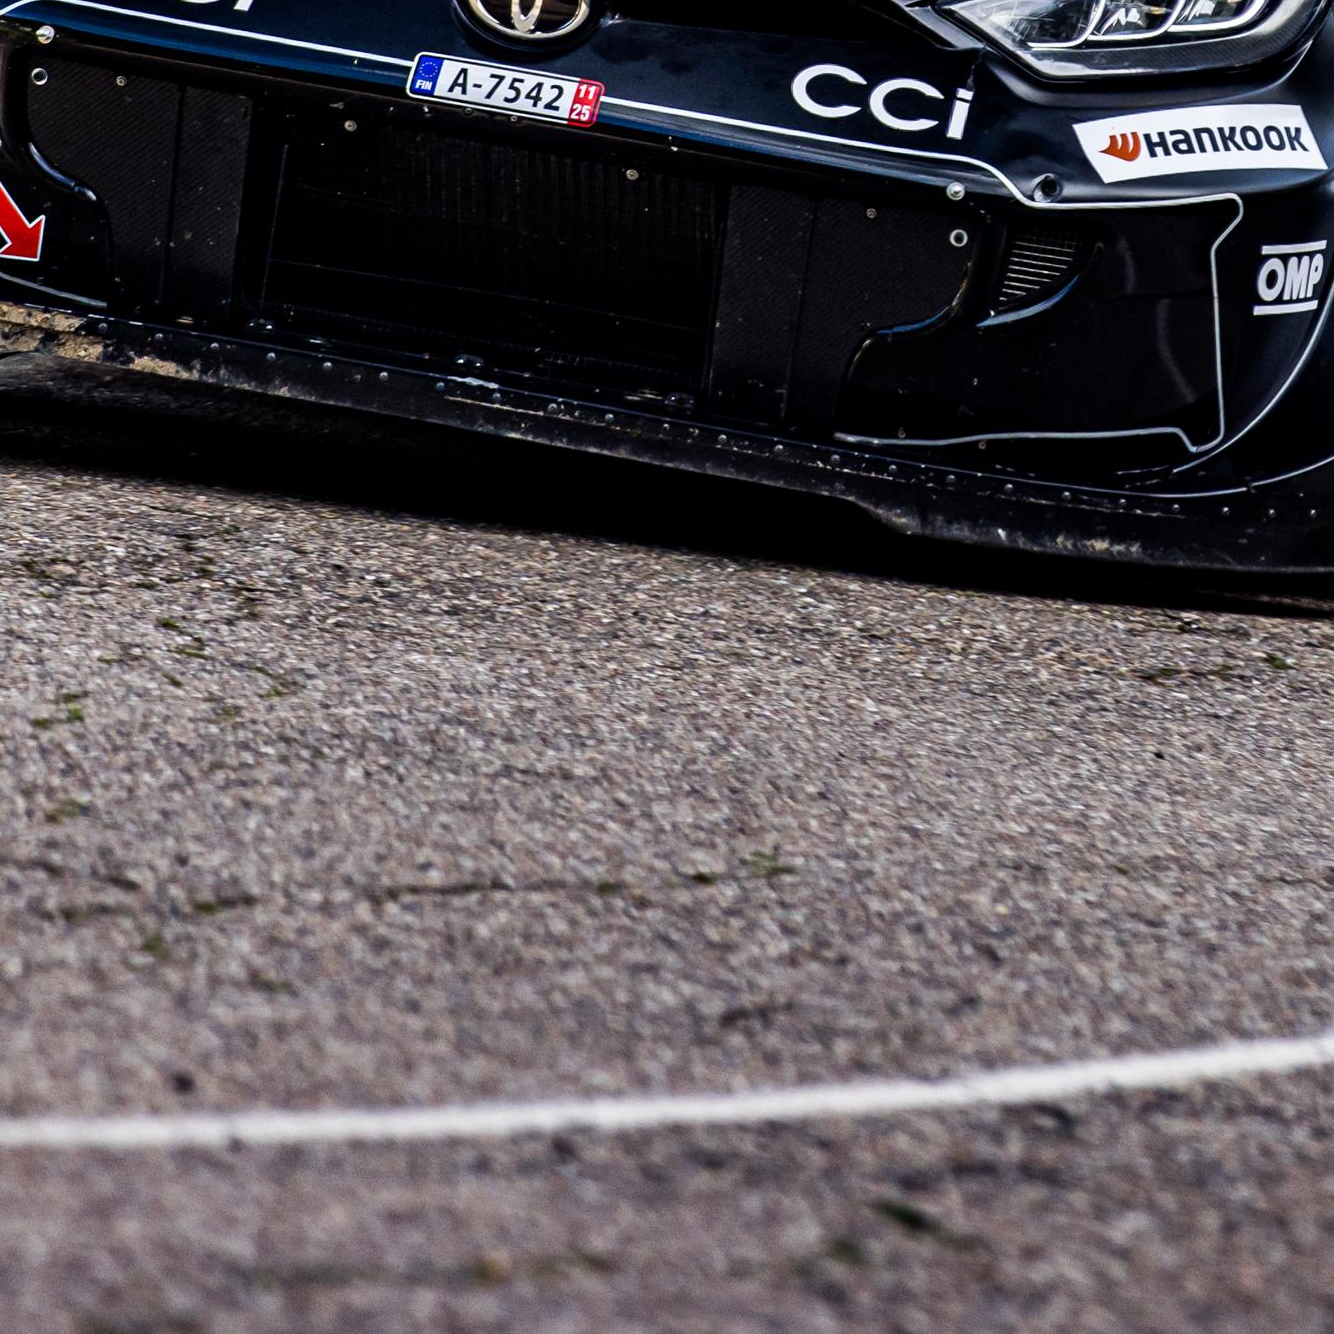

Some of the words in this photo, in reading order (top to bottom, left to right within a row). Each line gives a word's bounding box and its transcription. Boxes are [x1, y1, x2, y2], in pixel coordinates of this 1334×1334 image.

[415, 79, 432, 91] FIN
[447, 67, 564, 112] A-7542
[578, 84, 596, 101] 11
[570, 103, 591, 122] 25
[1257, 254, 1323, 303] OMP
